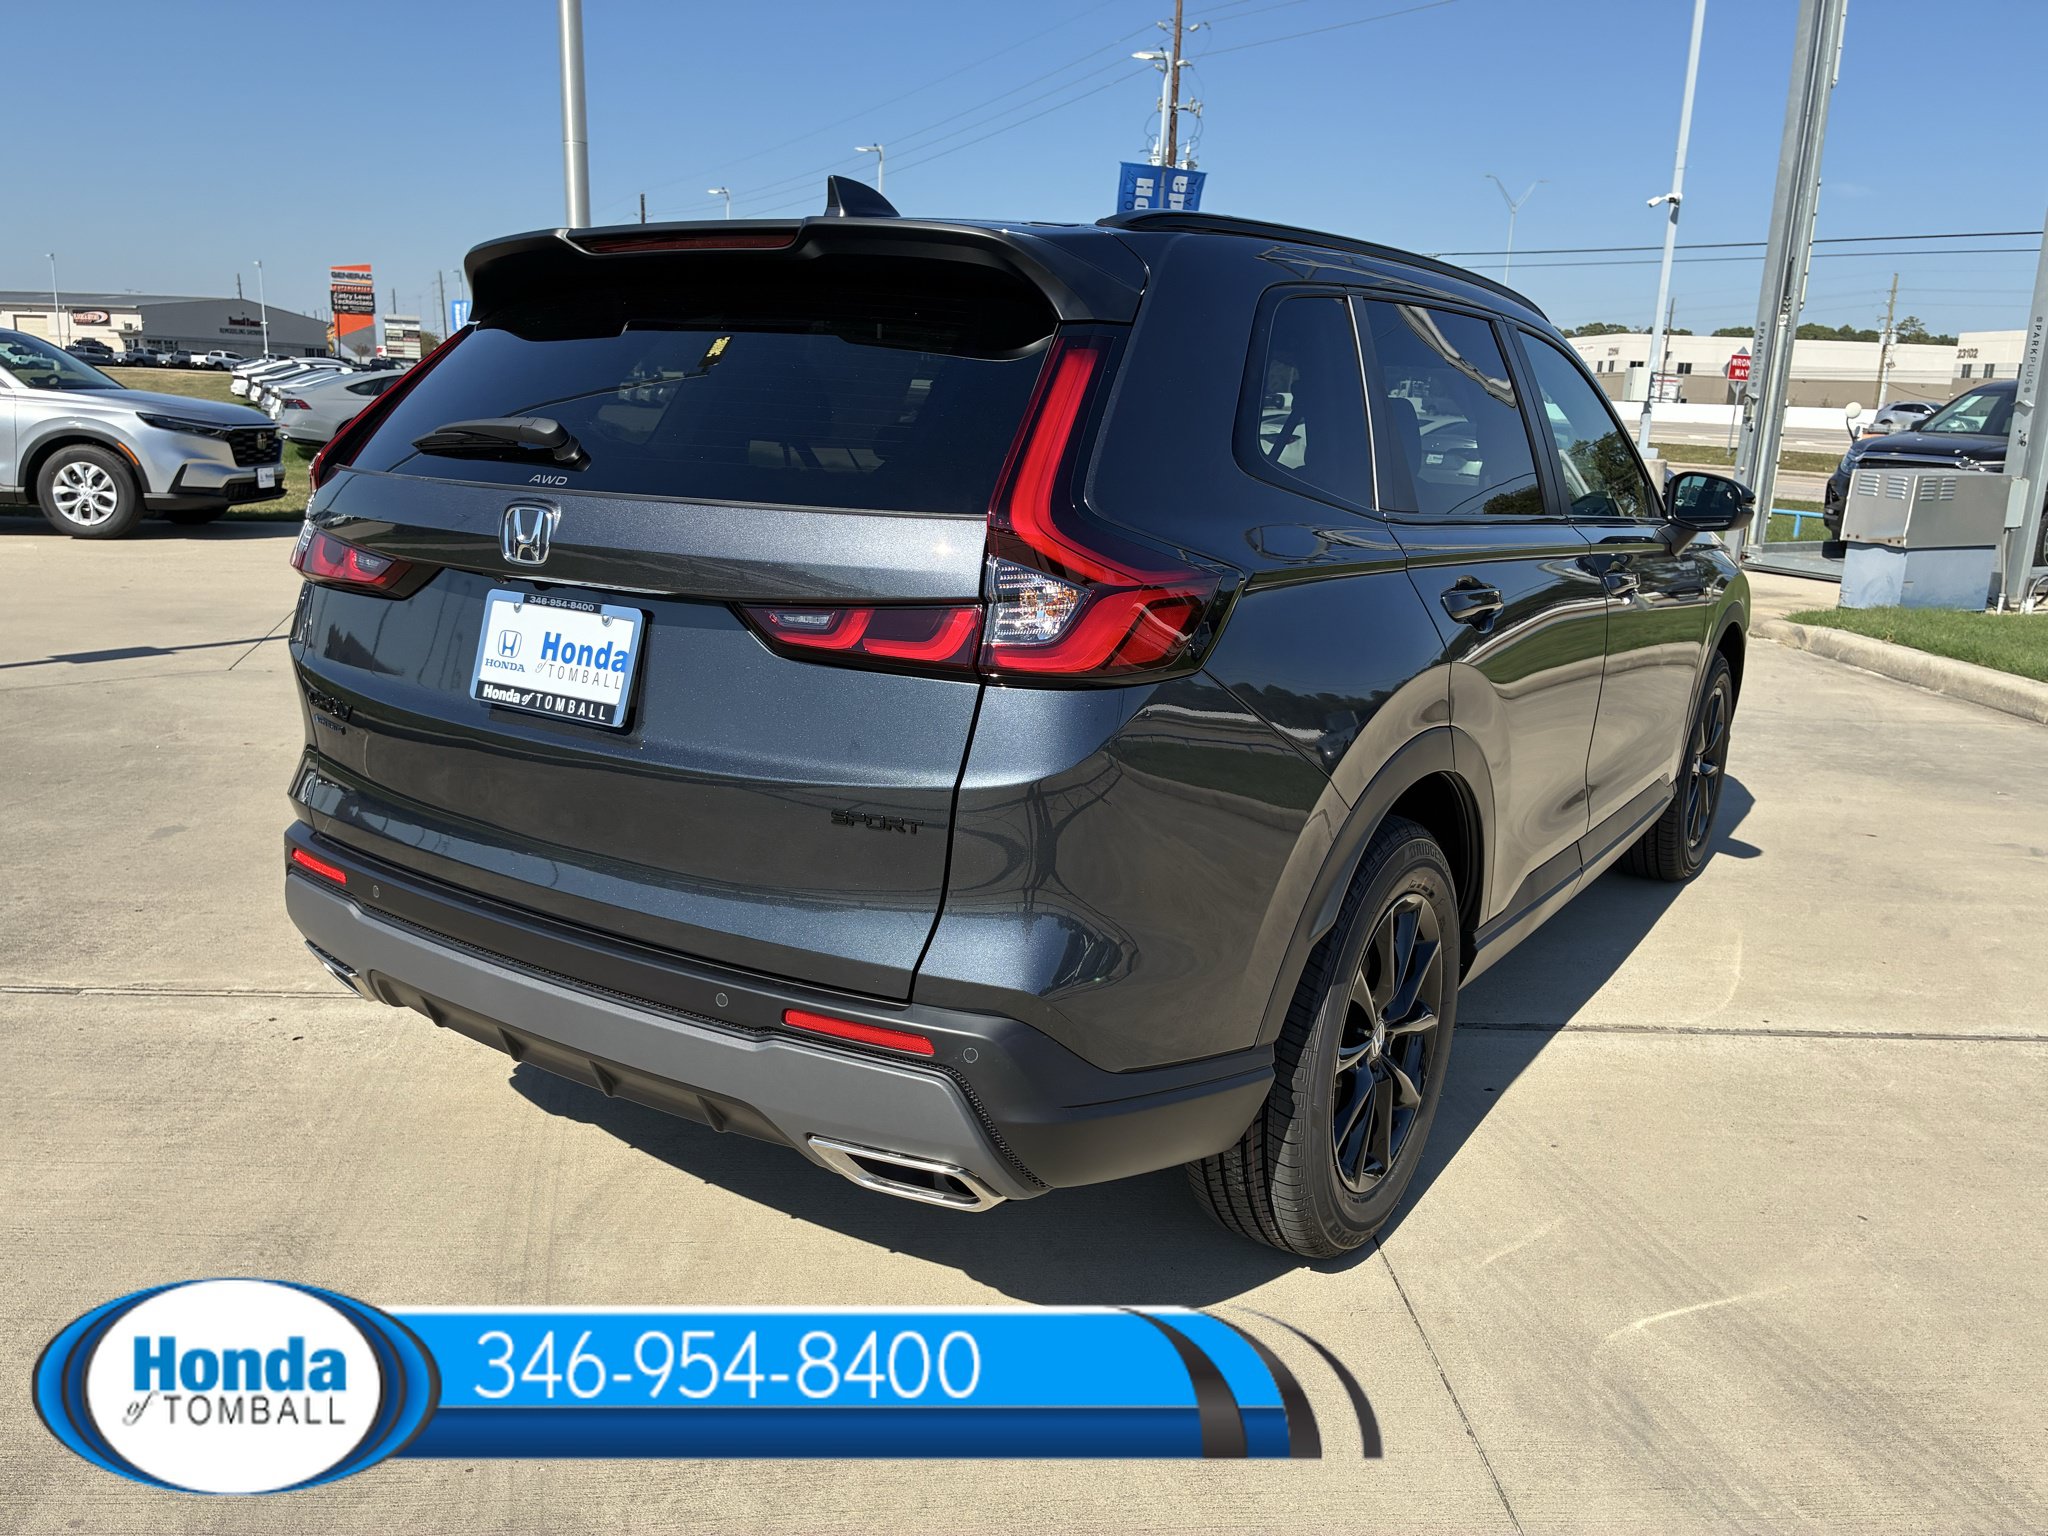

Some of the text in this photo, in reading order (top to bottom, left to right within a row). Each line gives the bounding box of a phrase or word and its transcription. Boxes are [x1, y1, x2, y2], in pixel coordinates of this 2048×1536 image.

[331, 271, 372, 280] GENERAC
[333, 292, 353, 301] Entry
[1957, 348, 1979, 359] 23102
[1732, 358, 1751, 367] WRON
[1734, 368, 1750, 377] WAY
[529, 474, 568, 486] AWD
[541, 631, 629, 672] Honda
[485, 658, 525, 672] HONDA
[549, 663, 620, 690] TOMBALL
[483, 684, 606, 720] Honda of TOMBALL
[831, 809, 924, 835] SPORT
